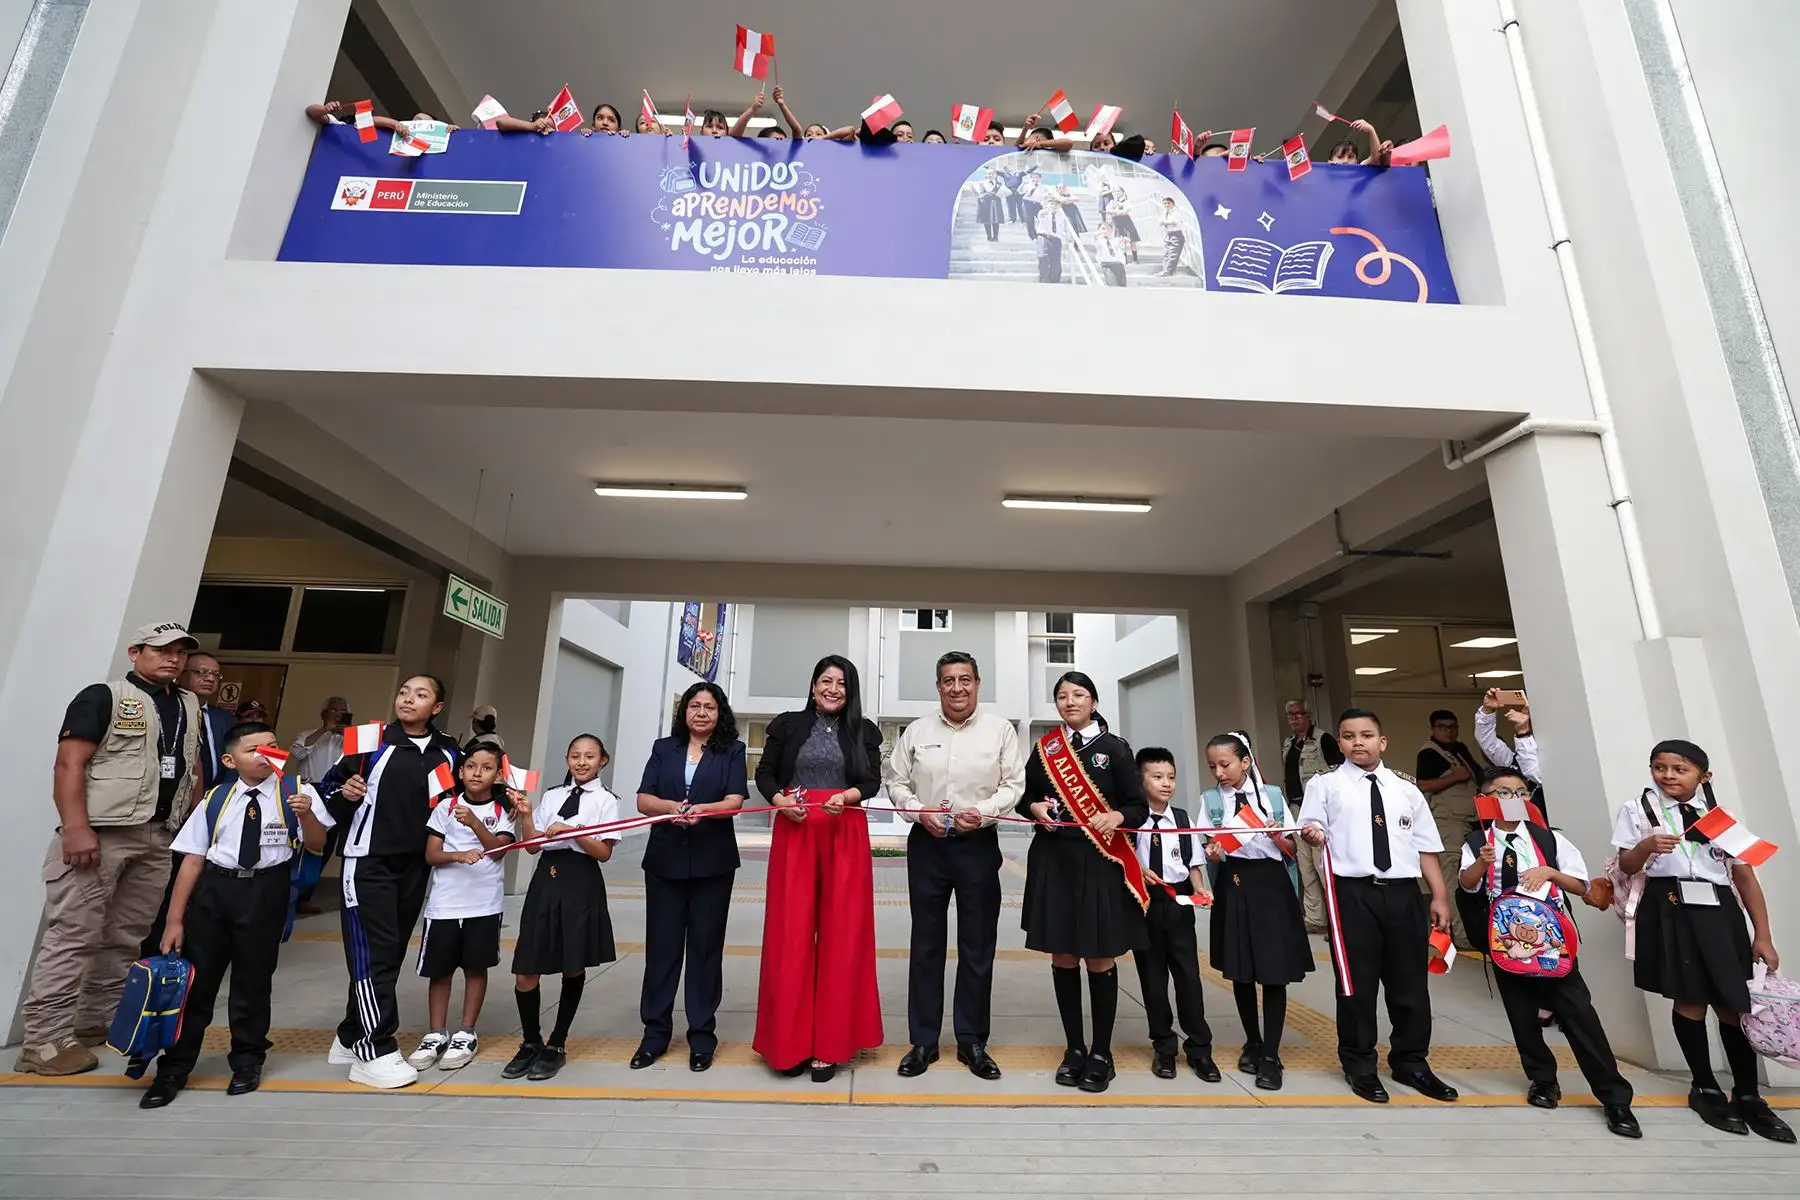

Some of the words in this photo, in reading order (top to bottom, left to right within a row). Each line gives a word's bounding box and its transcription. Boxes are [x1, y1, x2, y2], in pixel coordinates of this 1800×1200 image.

[377, 190, 405, 200] PERÚ
[416, 191, 459, 200] Ministerio
[414, 199, 425, 207] de
[427, 199, 469, 208] Educación
[741, 254, 756, 264] La
[758, 255, 817, 265] educación
[710, 265, 731, 273] nos
[762, 266, 787, 275] más
[472, 596, 501, 629] SALIDA
[1053, 756, 1115, 846] ALCALDA
